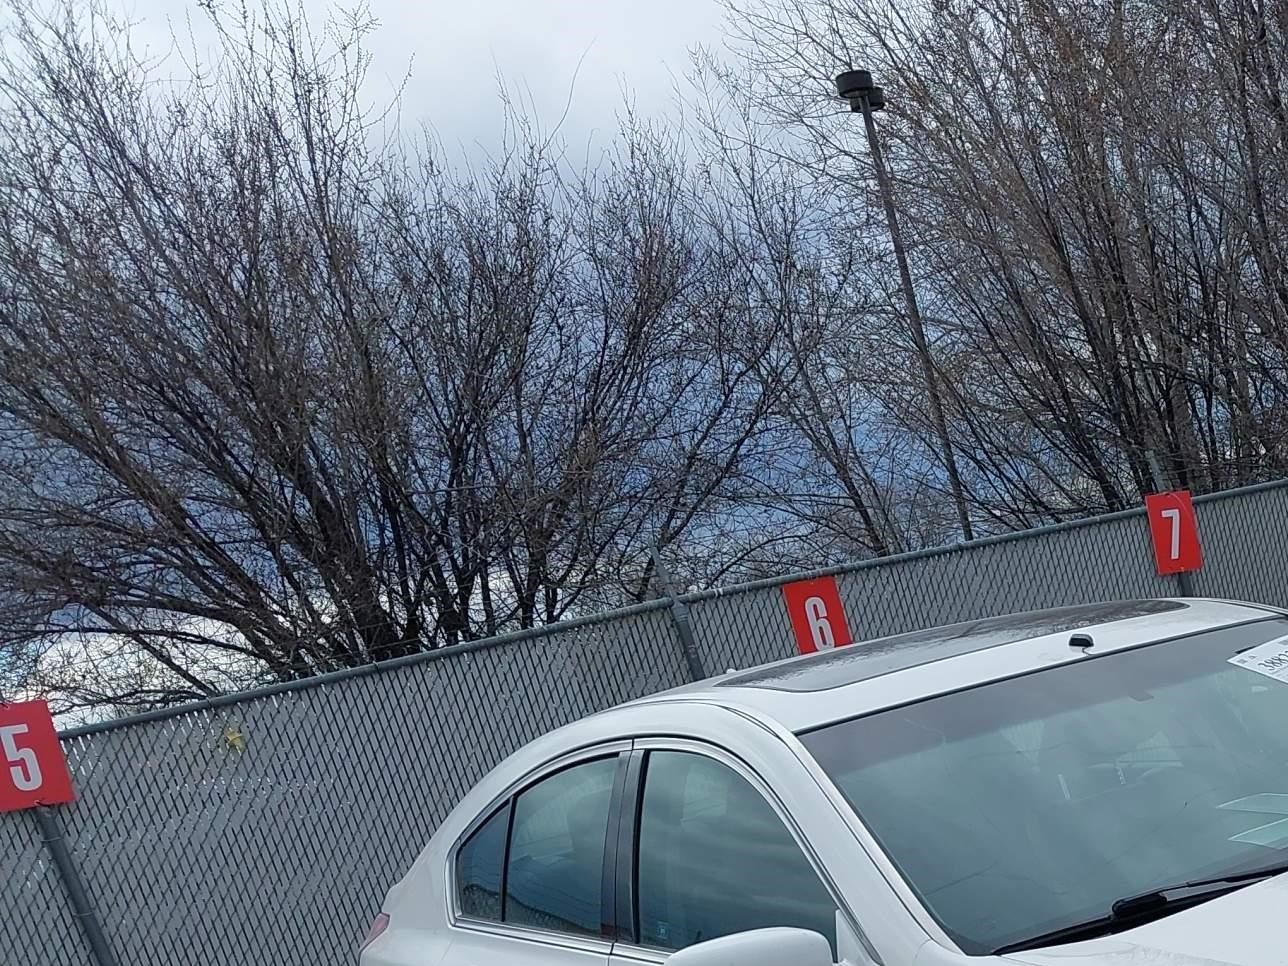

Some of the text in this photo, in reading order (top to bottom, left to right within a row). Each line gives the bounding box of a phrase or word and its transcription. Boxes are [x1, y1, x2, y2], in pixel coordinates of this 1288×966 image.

[1161, 508, 1180, 560] 7
[804, 596, 836, 652] 6
[0, 723, 43, 792] 5
